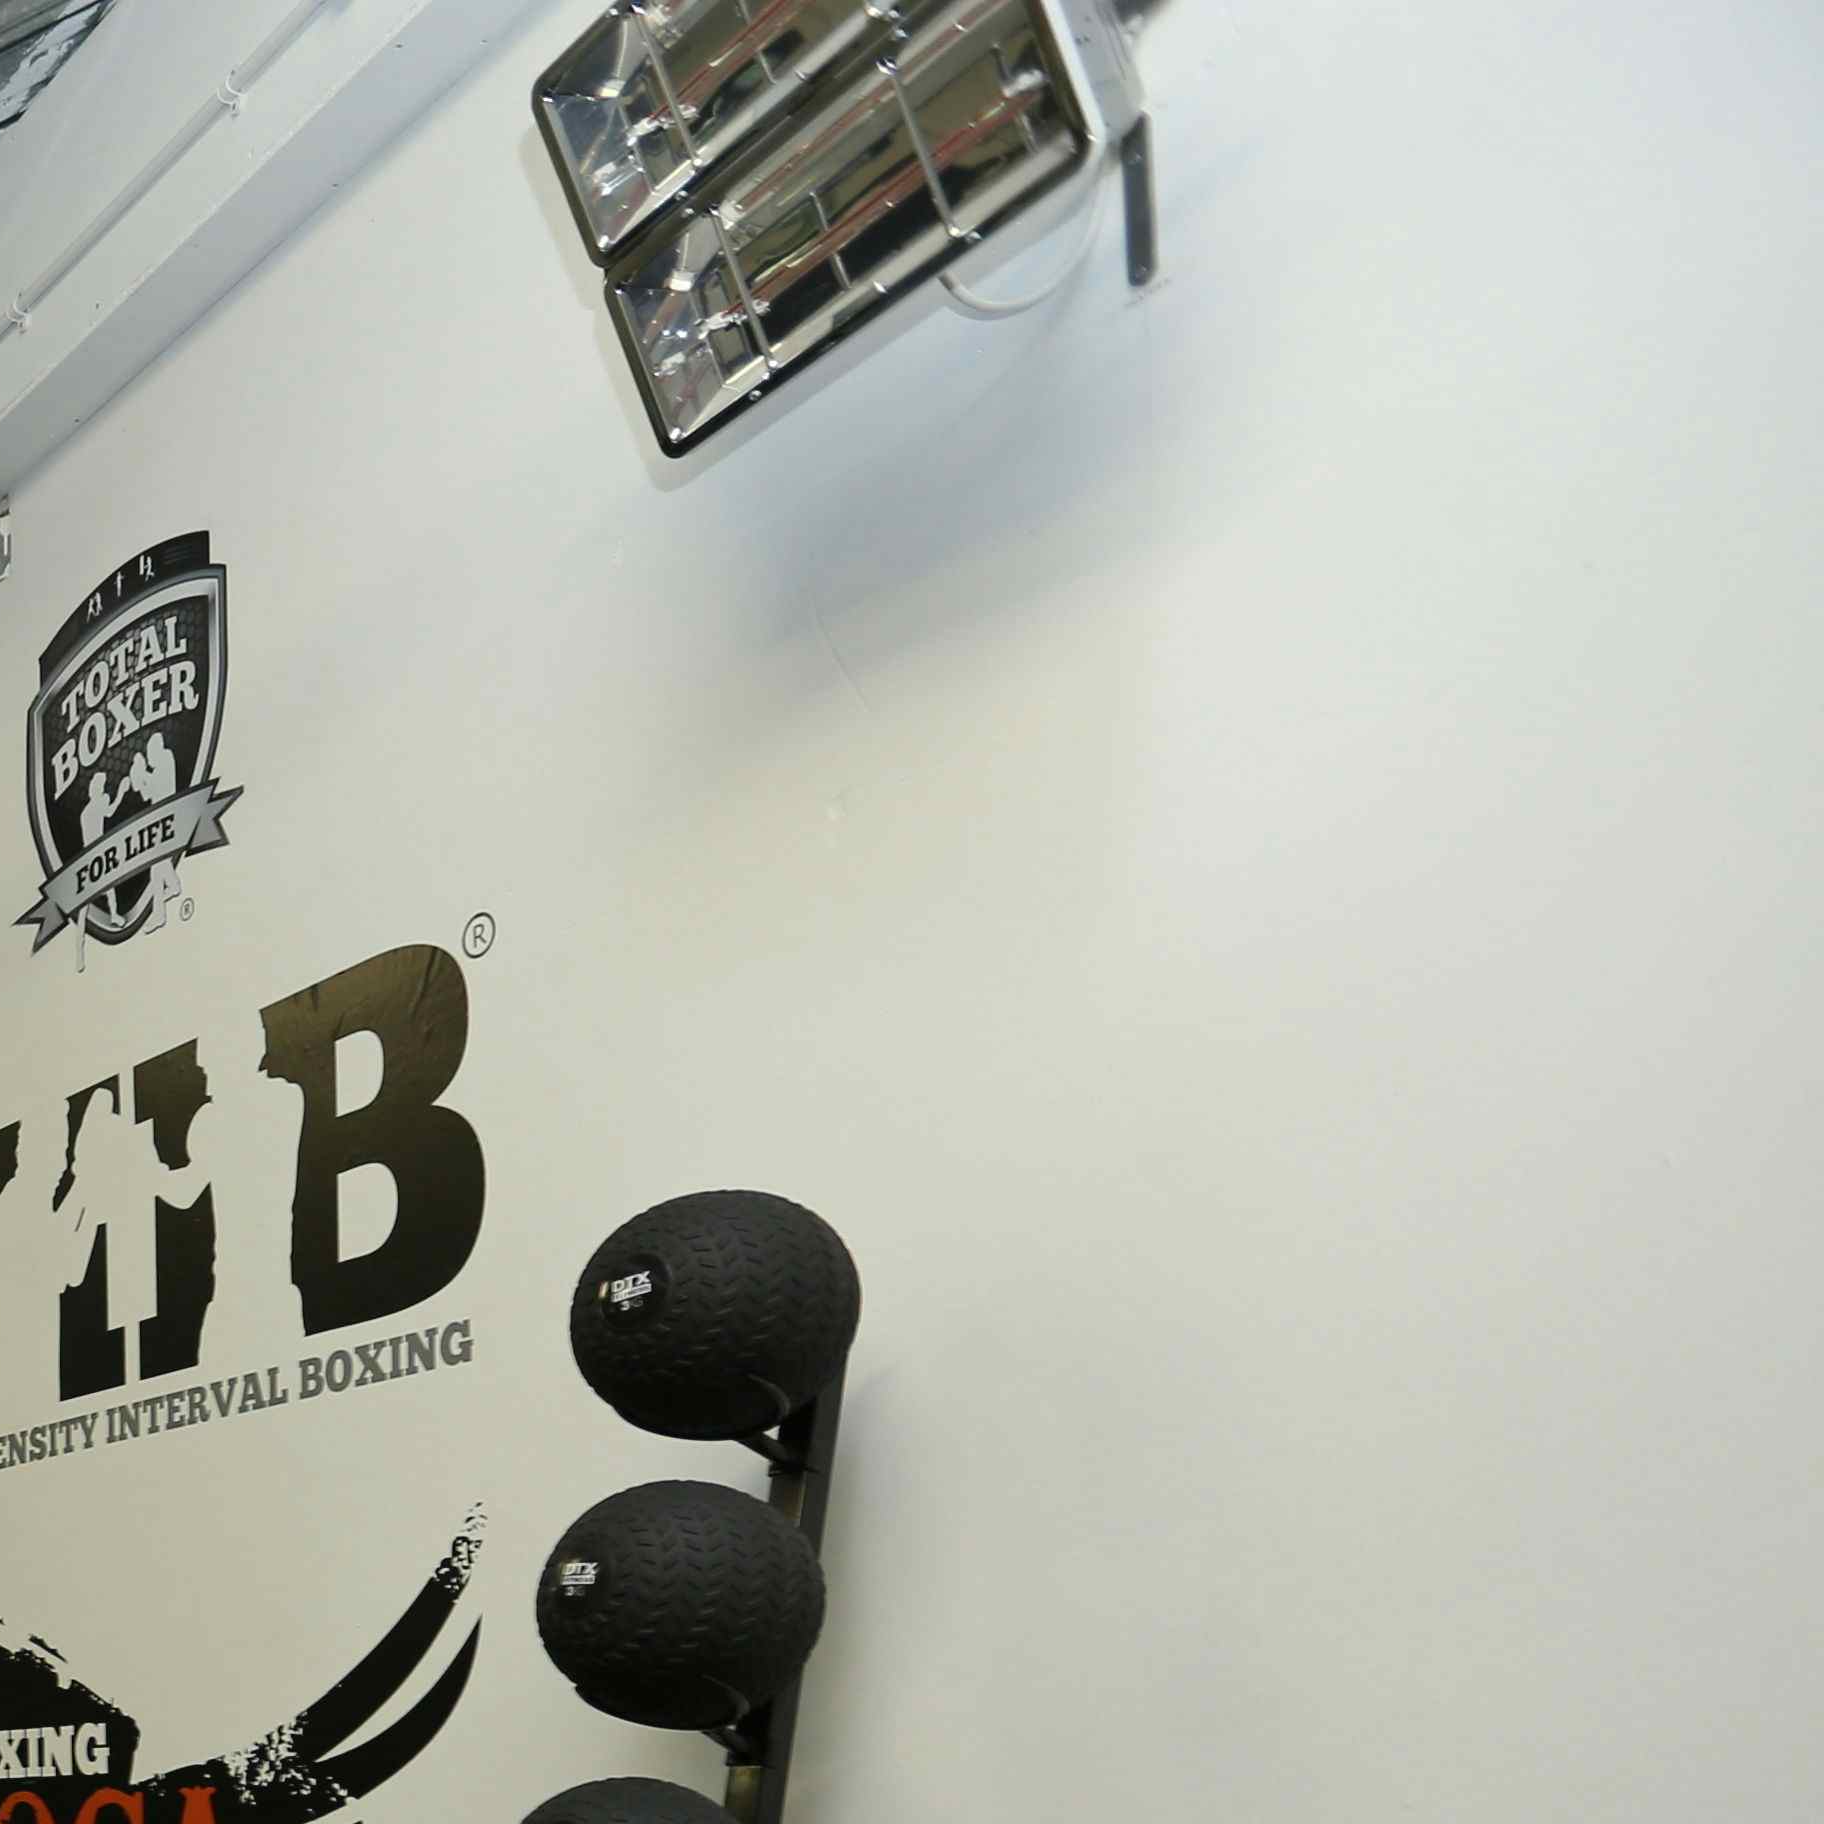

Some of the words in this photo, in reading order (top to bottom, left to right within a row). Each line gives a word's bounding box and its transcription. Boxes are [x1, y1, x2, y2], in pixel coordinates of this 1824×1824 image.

[61, 615, 187, 733] TOTAL
[51, 660, 200, 800] BOXER
[75, 854, 121, 895] FOR
[124, 814, 176, 860] LIFE
[611, 1270, 650, 1293] DTX
[106, 1368, 289, 1444] INTERVAL
[299, 1319, 475, 1400] BOXING
[562, 1562, 599, 1576] DTX
